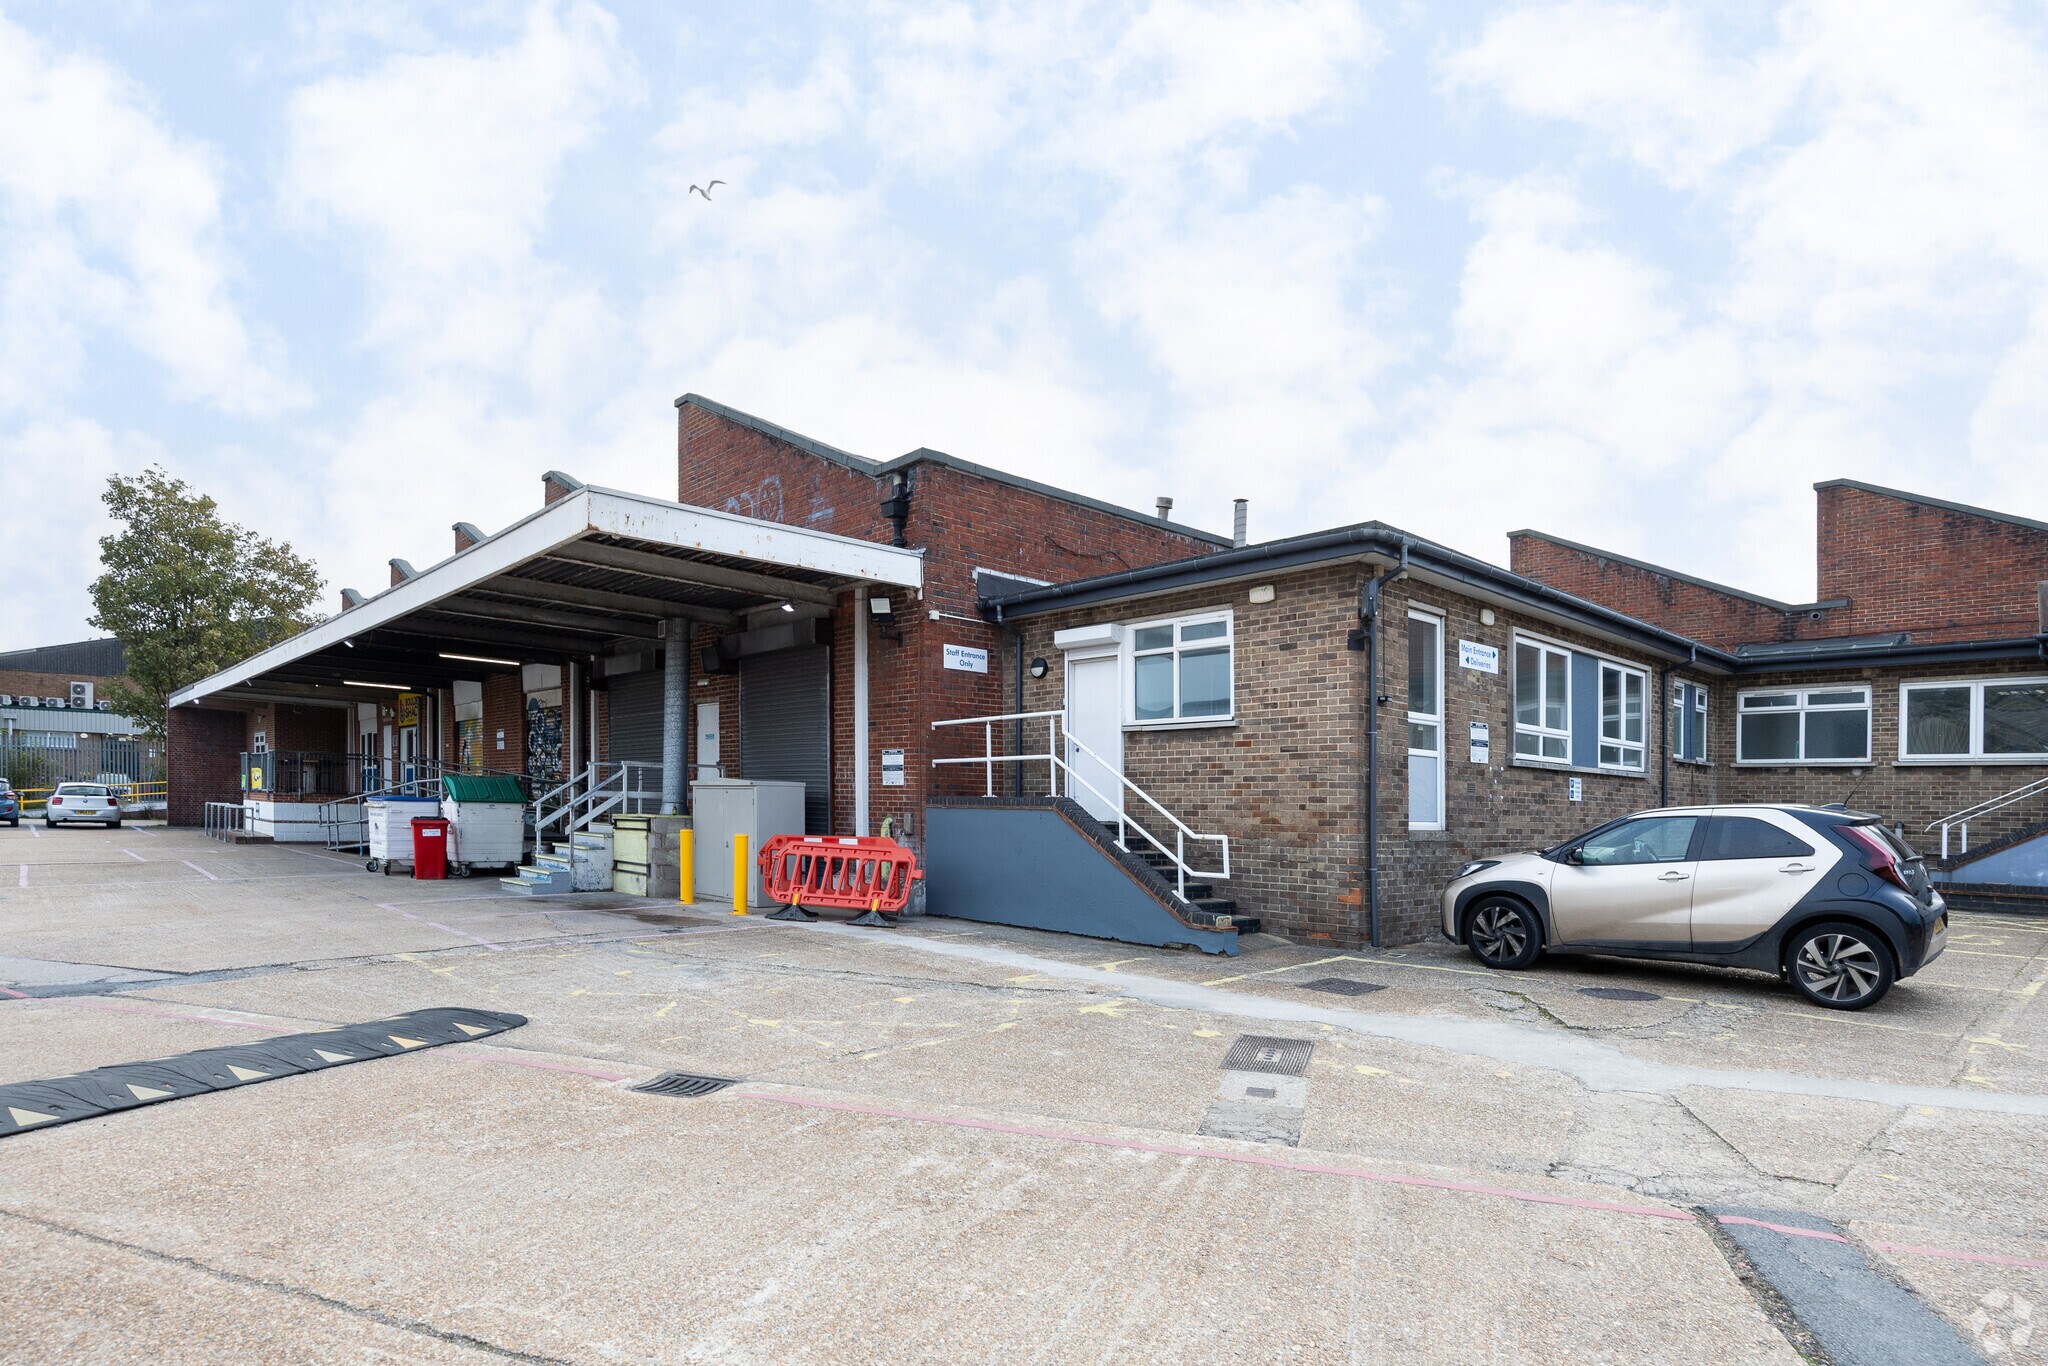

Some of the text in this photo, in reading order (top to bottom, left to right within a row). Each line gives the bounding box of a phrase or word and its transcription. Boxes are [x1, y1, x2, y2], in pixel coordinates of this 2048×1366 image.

[946, 648, 985, 660] Staff Entrance
[1461, 644, 1491, 658] Main Entrance
[959, 660, 973, 669] Only
[1471, 657, 1491, 669] Deliveries
